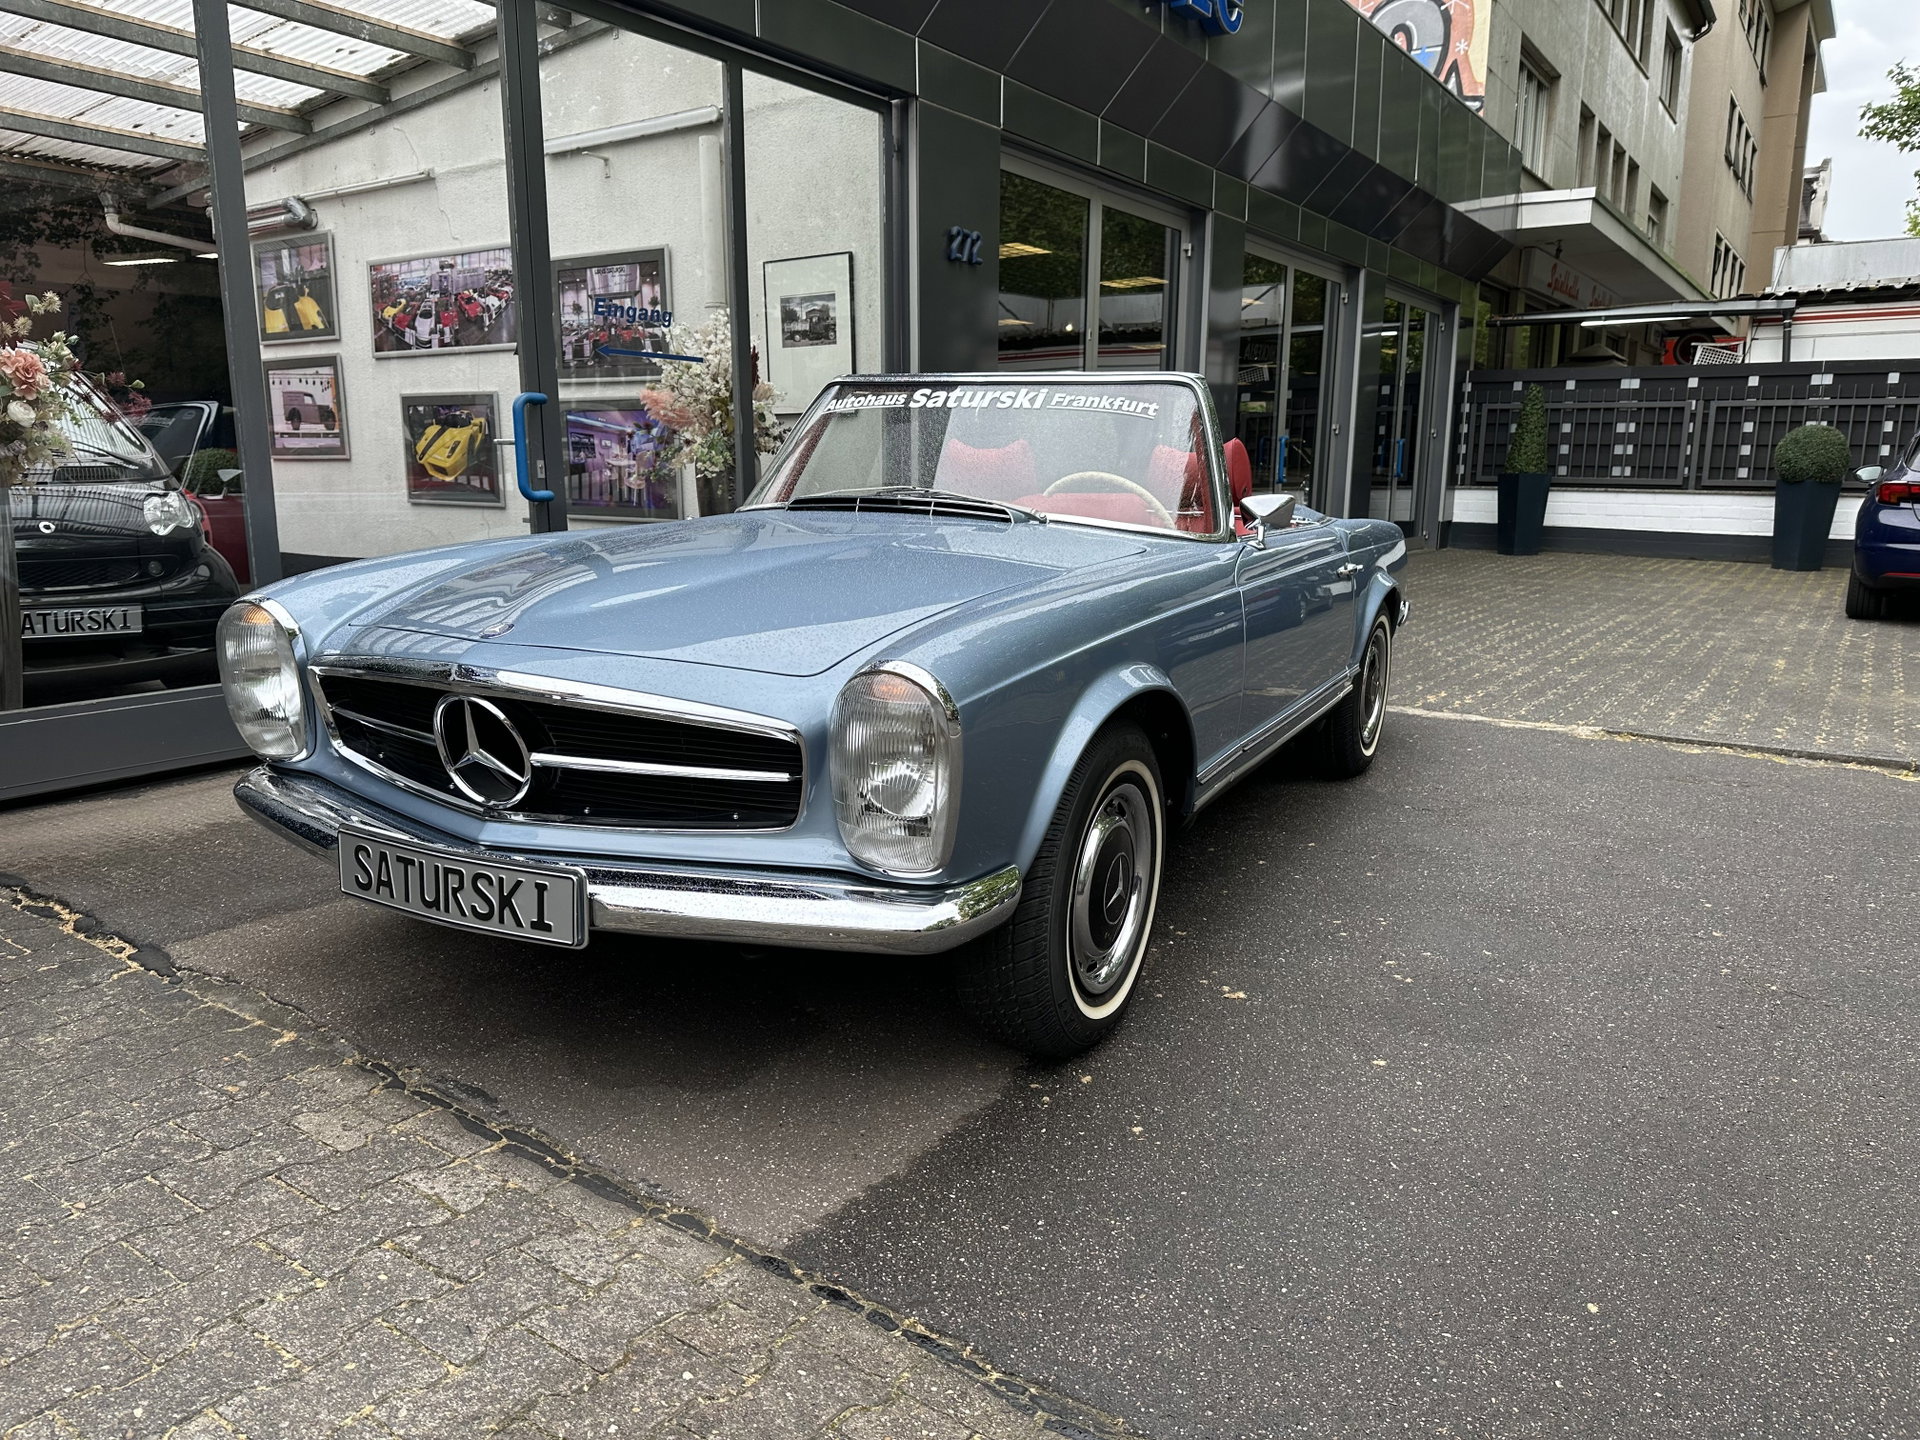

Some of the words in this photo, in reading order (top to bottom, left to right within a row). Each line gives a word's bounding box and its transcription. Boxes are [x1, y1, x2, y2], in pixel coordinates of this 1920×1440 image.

[949, 225, 984, 265] 272
[593, 297, 673, 328] Eingang
[824, 391, 907, 413] Autohaus
[908, 387, 1049, 411] Saturski
[1050, 392, 1160, 417] Frankfurt
[20, 608, 131, 635] ATURSKI
[353, 843, 554, 933] SATURSKI
